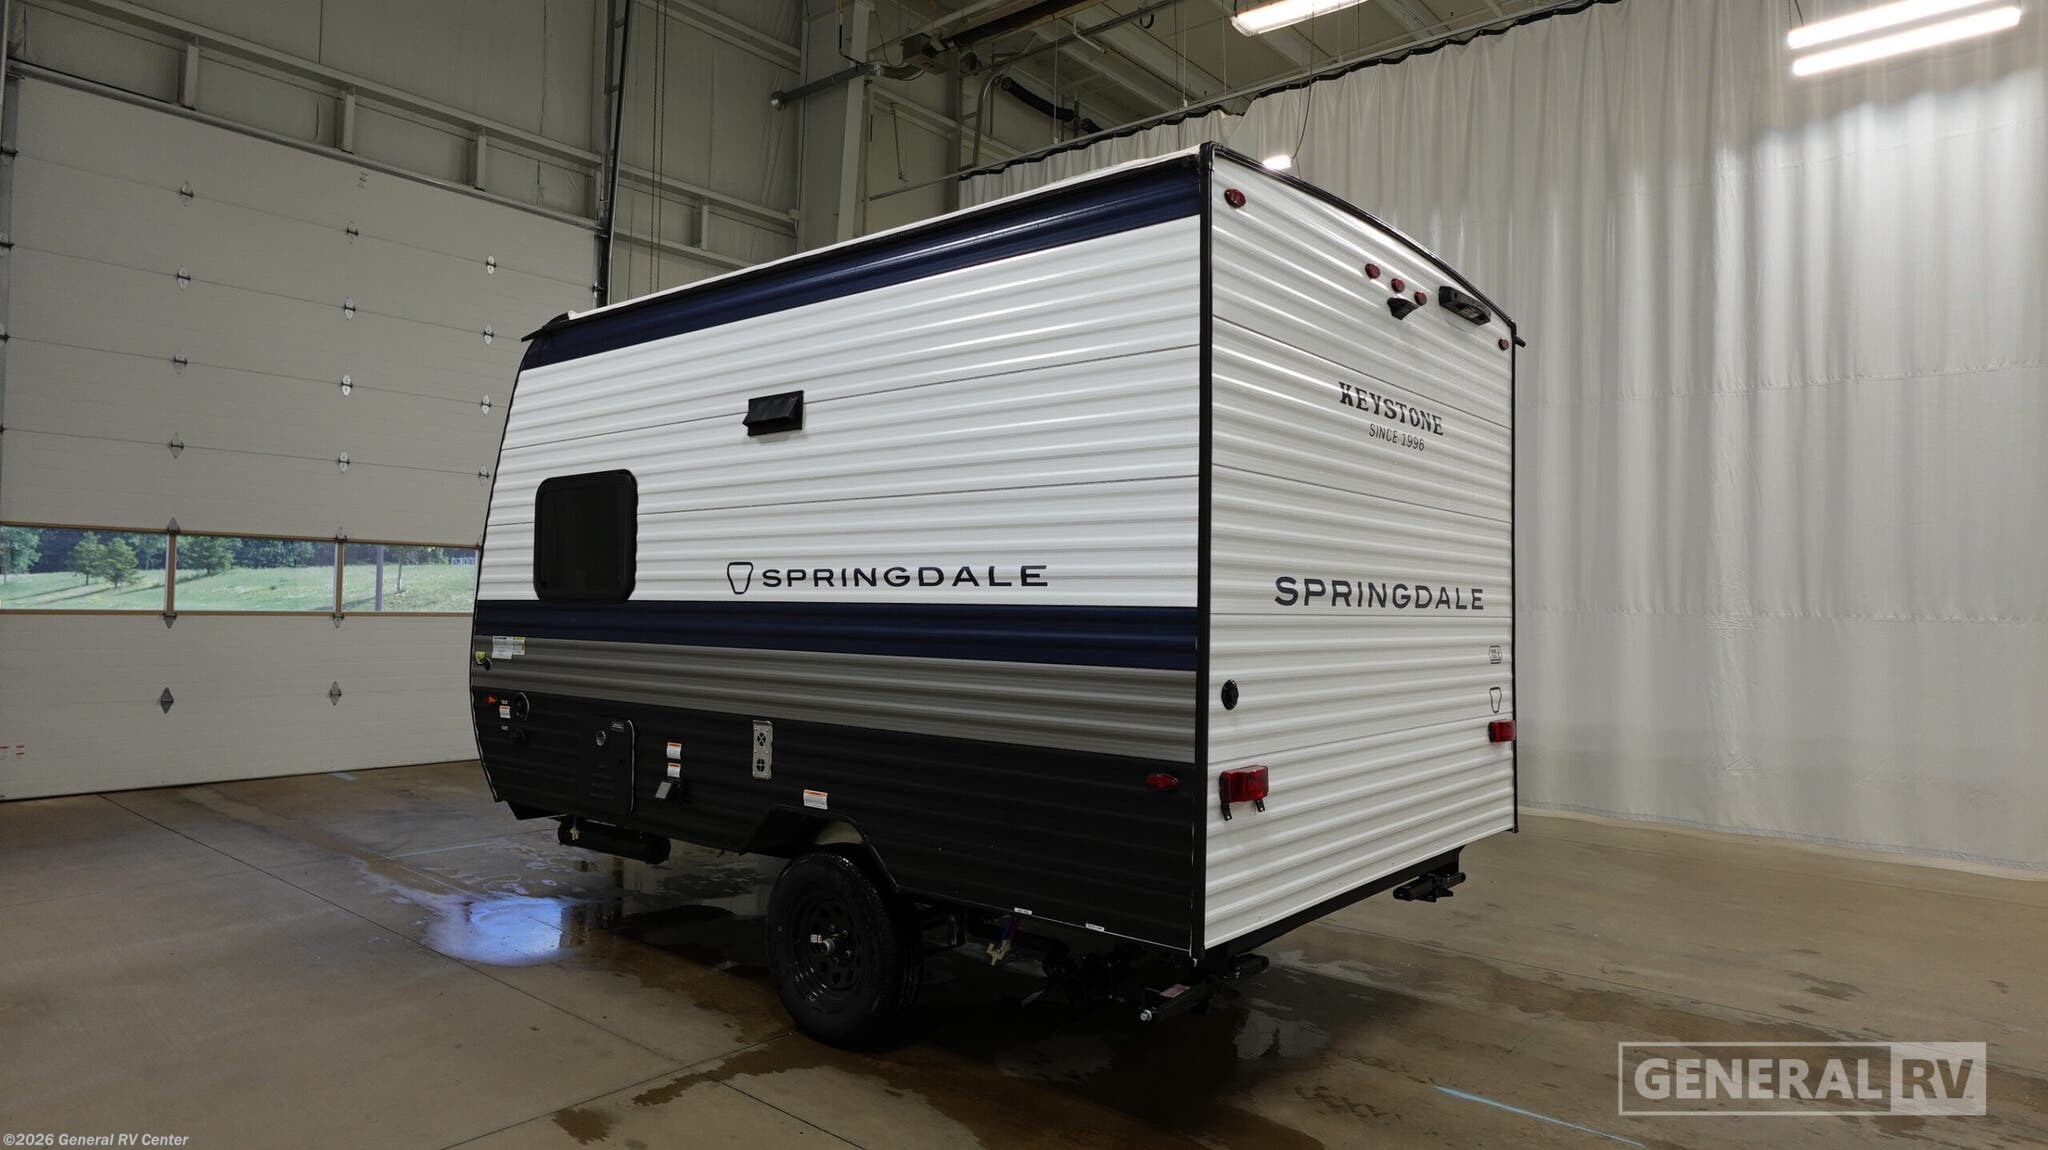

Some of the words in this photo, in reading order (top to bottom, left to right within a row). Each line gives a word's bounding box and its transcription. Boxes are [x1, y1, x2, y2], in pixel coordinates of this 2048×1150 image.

[1338, 381, 1444, 436] KEYSTONE
[1368, 423, 1398, 444] SINCE
[1400, 433, 1425, 452] 1996
[762, 565, 1049, 588] SPRINGDALE
[1274, 576, 1485, 610] SPRINGDALE
